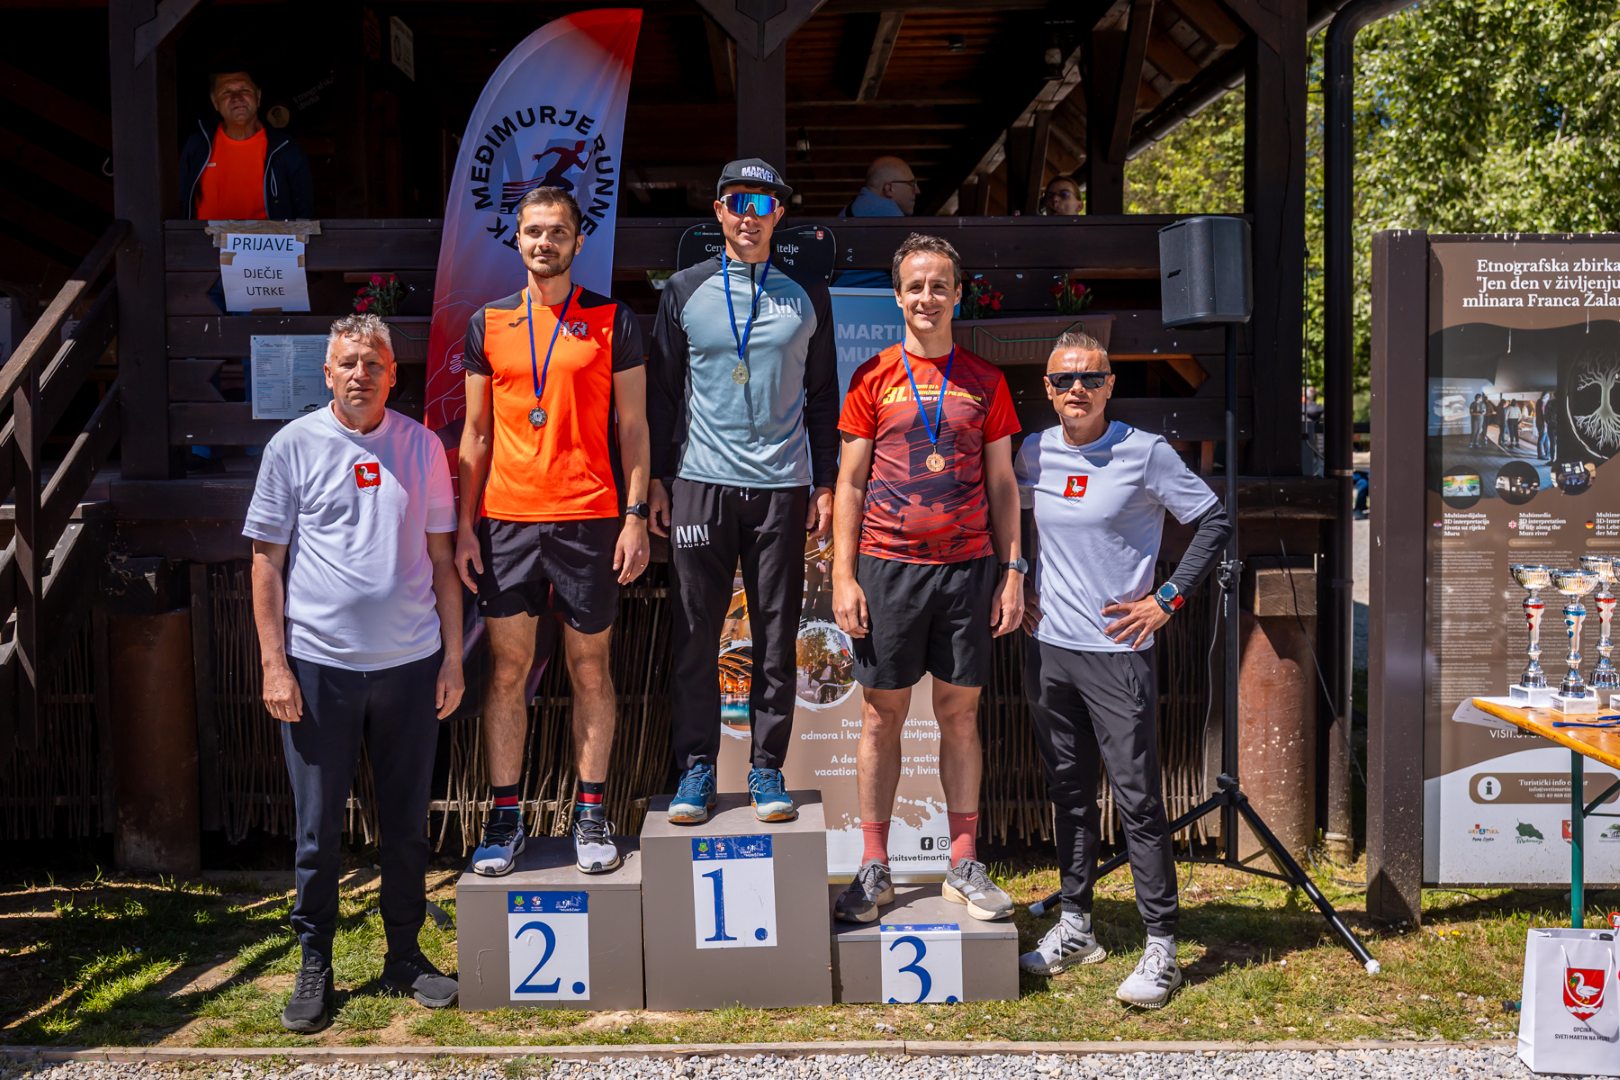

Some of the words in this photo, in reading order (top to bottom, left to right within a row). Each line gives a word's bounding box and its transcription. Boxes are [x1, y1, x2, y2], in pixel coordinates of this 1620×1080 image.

[471, 105, 595, 210] MEĐIMURJE
[581, 133, 615, 237] RUNNE
[232, 237, 294, 252] PRIJAVE
[243, 266, 284, 280] DJEČJE
[1477, 258, 1569, 275] Etnografska
[1573, 258, 1620, 272] zbirka
[246, 286, 286, 296] UTRKE
[1510, 275, 1540, 290] den
[1543, 280, 1552, 290] v
[1555, 275, 1620, 293] življenju
[1462, 294, 1523, 307] mlinara
[1527, 293, 1580, 307] Franca
[838, 324, 906, 340] MARTI
[904, 718, 939, 730] ktivnog
[800, 730, 838, 740] odmora
[841, 730, 844, 739] i
[831, 756, 838, 764] A
[814, 768, 857, 777] vacation
[702, 867, 768, 942] 1.
[514, 920, 586, 995] 2.
[888, 935, 958, 1004] 3.
